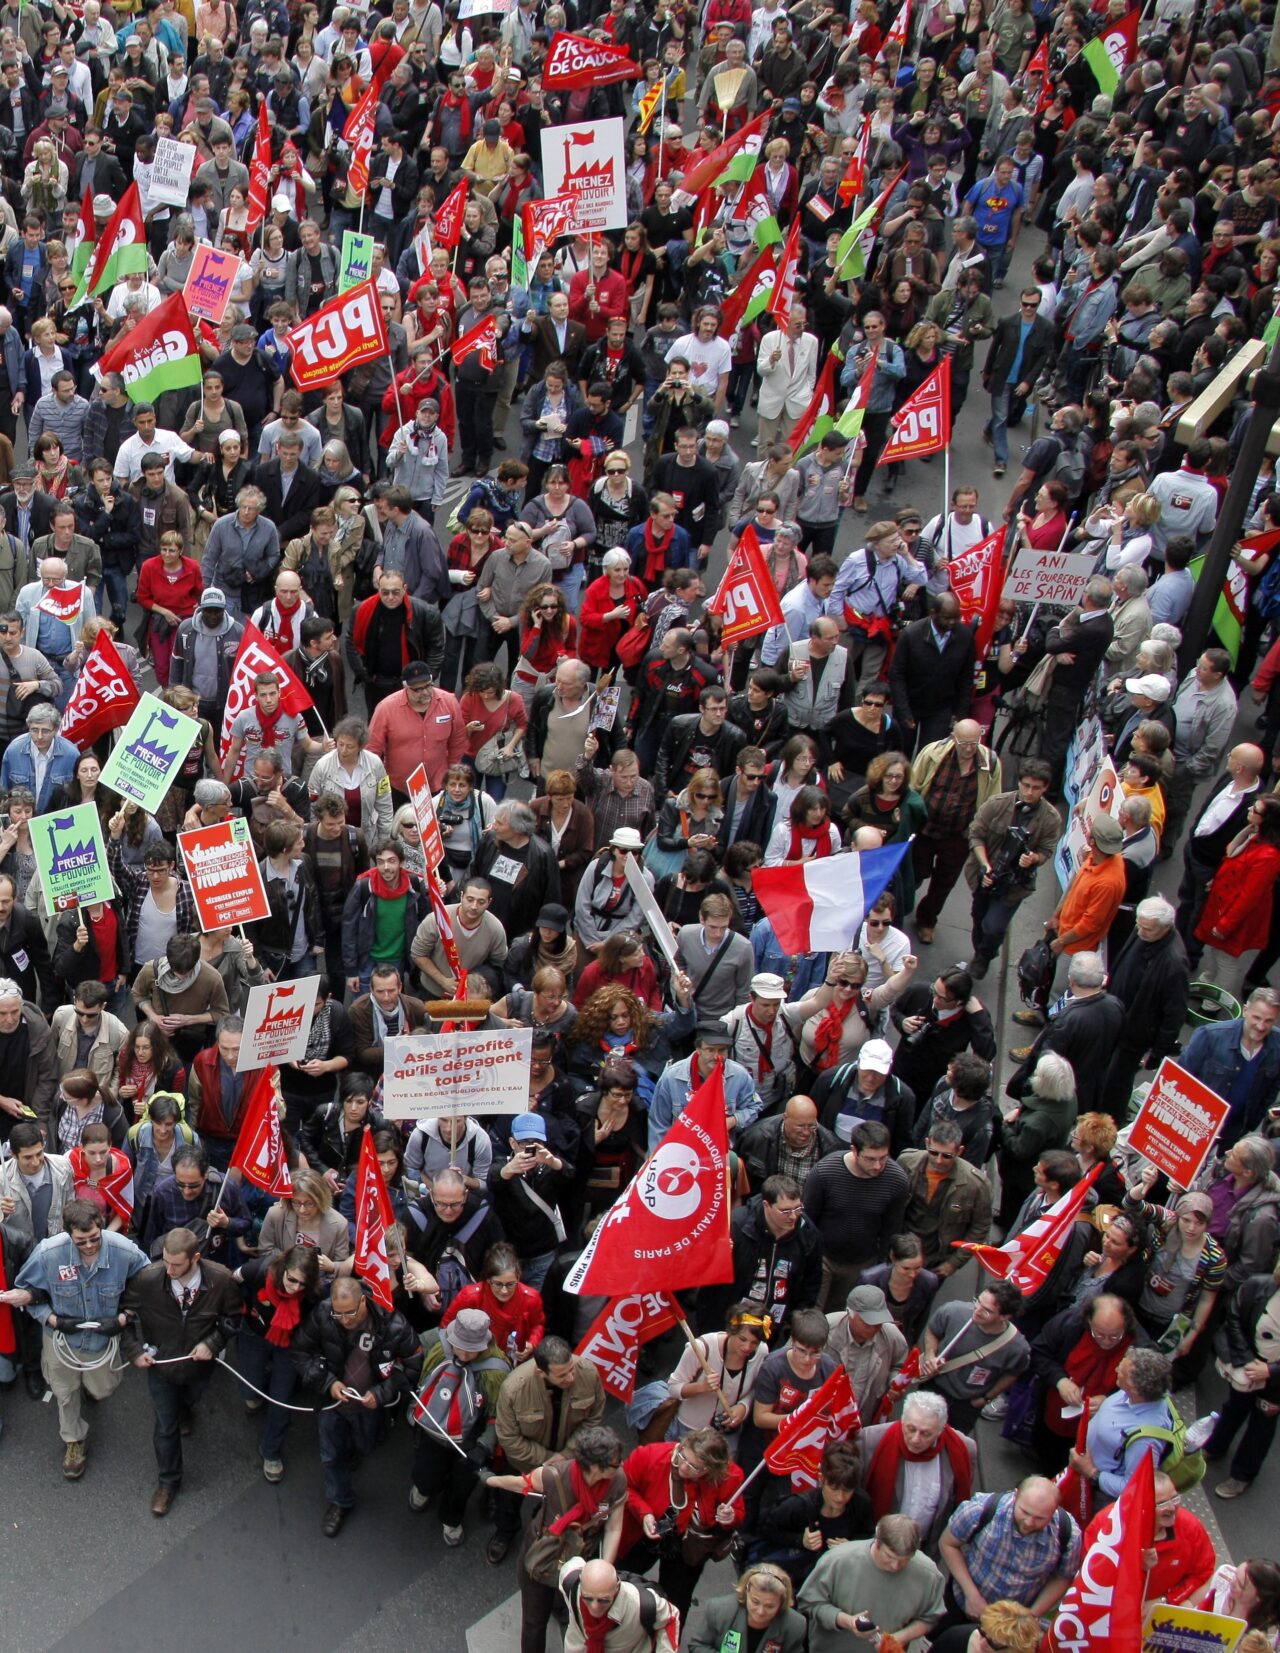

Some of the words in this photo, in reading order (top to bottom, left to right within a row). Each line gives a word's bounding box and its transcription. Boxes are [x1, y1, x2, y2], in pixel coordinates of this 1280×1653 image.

[548, 62, 568, 76] DE
[568, 173, 611, 191] PRENEZ
[582, 187, 609, 201] UVOIR
[1174, 496, 1183, 506] 6
[1012, 568, 1031, 580] LES
[1035, 570, 1087, 587] FOURBERIES
[1014, 581, 1033, 596] DE
[134, 744, 169, 772] PRENEZ
[120, 751, 130, 761] LE
[130, 756, 162, 781] POUVOIR
[116, 780, 128, 789] PCF
[58, 852, 96, 871] PRENEZ
[50, 874, 60, 885] LE
[61, 864, 96, 882] POUVOIR
[58, 896, 68, 908] 6
[218, 912, 232, 922] PCF
[266, 1016, 301, 1031] PRENEZ
[254, 1032, 262, 1040] LE
[264, 1026, 297, 1039] POUVOIR
[403, 1049, 453, 1064] Assez
[456, 1037, 514, 1058] profité
[394, 1064, 438, 1080] qu'ils
[442, 1051, 523, 1072] dégagent
[434, 1072, 471, 1087] tous
[450, 1086, 490, 1095] PUBLIQUES
[690, 1123, 723, 1171] PUBLIQUE
[1144, 1144, 1158, 1157] PCF
[644, 1158, 658, 1208] USAP
[690, 1182, 724, 1239] HÔPITAUX
[212, 1234, 220, 1248] 6
[296, 1232, 304, 1245] 6
[675, 1236, 692, 1252] DE
[633, 1246, 672, 1259] PARIS
[60, 1266, 78, 1280] PCF
[569, 1263, 588, 1288] PARIS
[1150, 1274, 1161, 1288] 6
[783, 1388, 796, 1396] PCF
